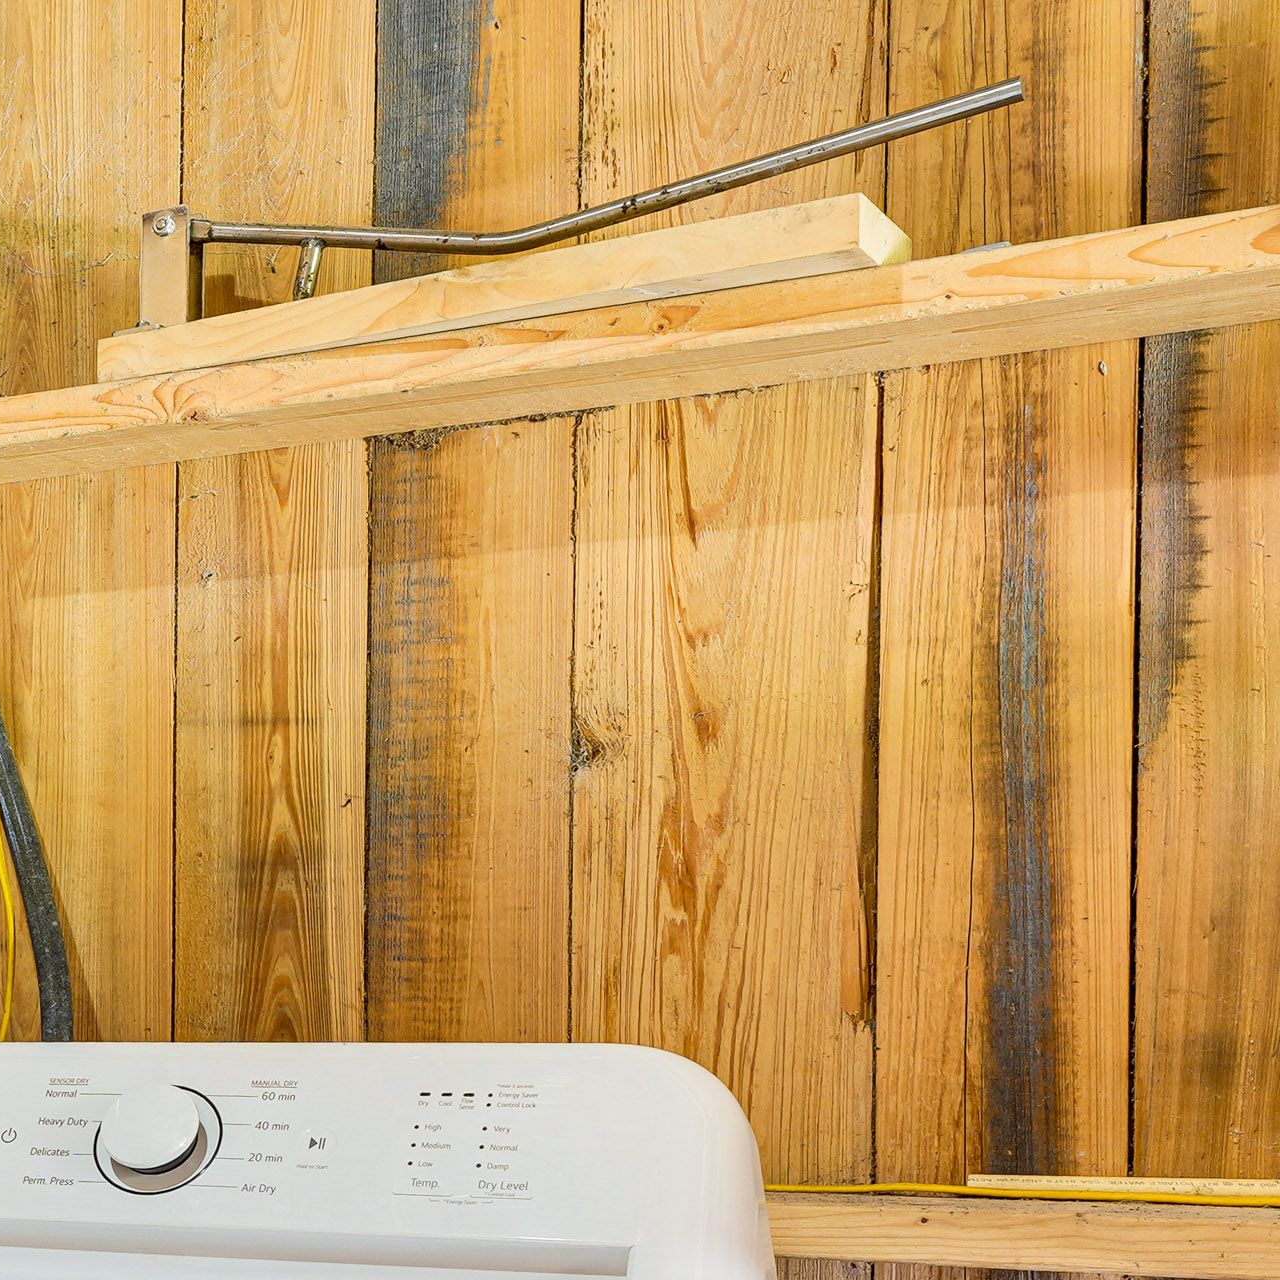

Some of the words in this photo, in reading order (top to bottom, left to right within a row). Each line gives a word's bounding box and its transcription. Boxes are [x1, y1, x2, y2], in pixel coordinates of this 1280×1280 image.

[45, 1090, 78, 1098] Normal
[261, 1091, 276, 1101] 60
[277, 1093, 296, 1101] min
[38, 1117, 65, 1128] Heavy
[67, 1117, 89, 1128] Duty
[255, 1121, 269, 1131] 40
[272, 1122, 290, 1131] min
[424, 1124, 442, 1132] High
[494, 1125, 511, 1134] Very
[421, 1142, 451, 1150] Medium
[30, 1147, 70, 1157] Delicates
[248, 1152, 263, 1162] 20
[264, 1154, 283, 1163] min
[487, 1162, 509, 1171] Damp
[22, 1176, 47, 1185] Perm.
[49, 1176, 74, 1186] Press
[410, 1178, 440, 1189] Temp.
[478, 1180, 497, 1191] Dry
[500, 1181, 529, 1191] Level
[241, 1183, 256, 1192] Air
[258, 1184, 277, 1195] Dry
